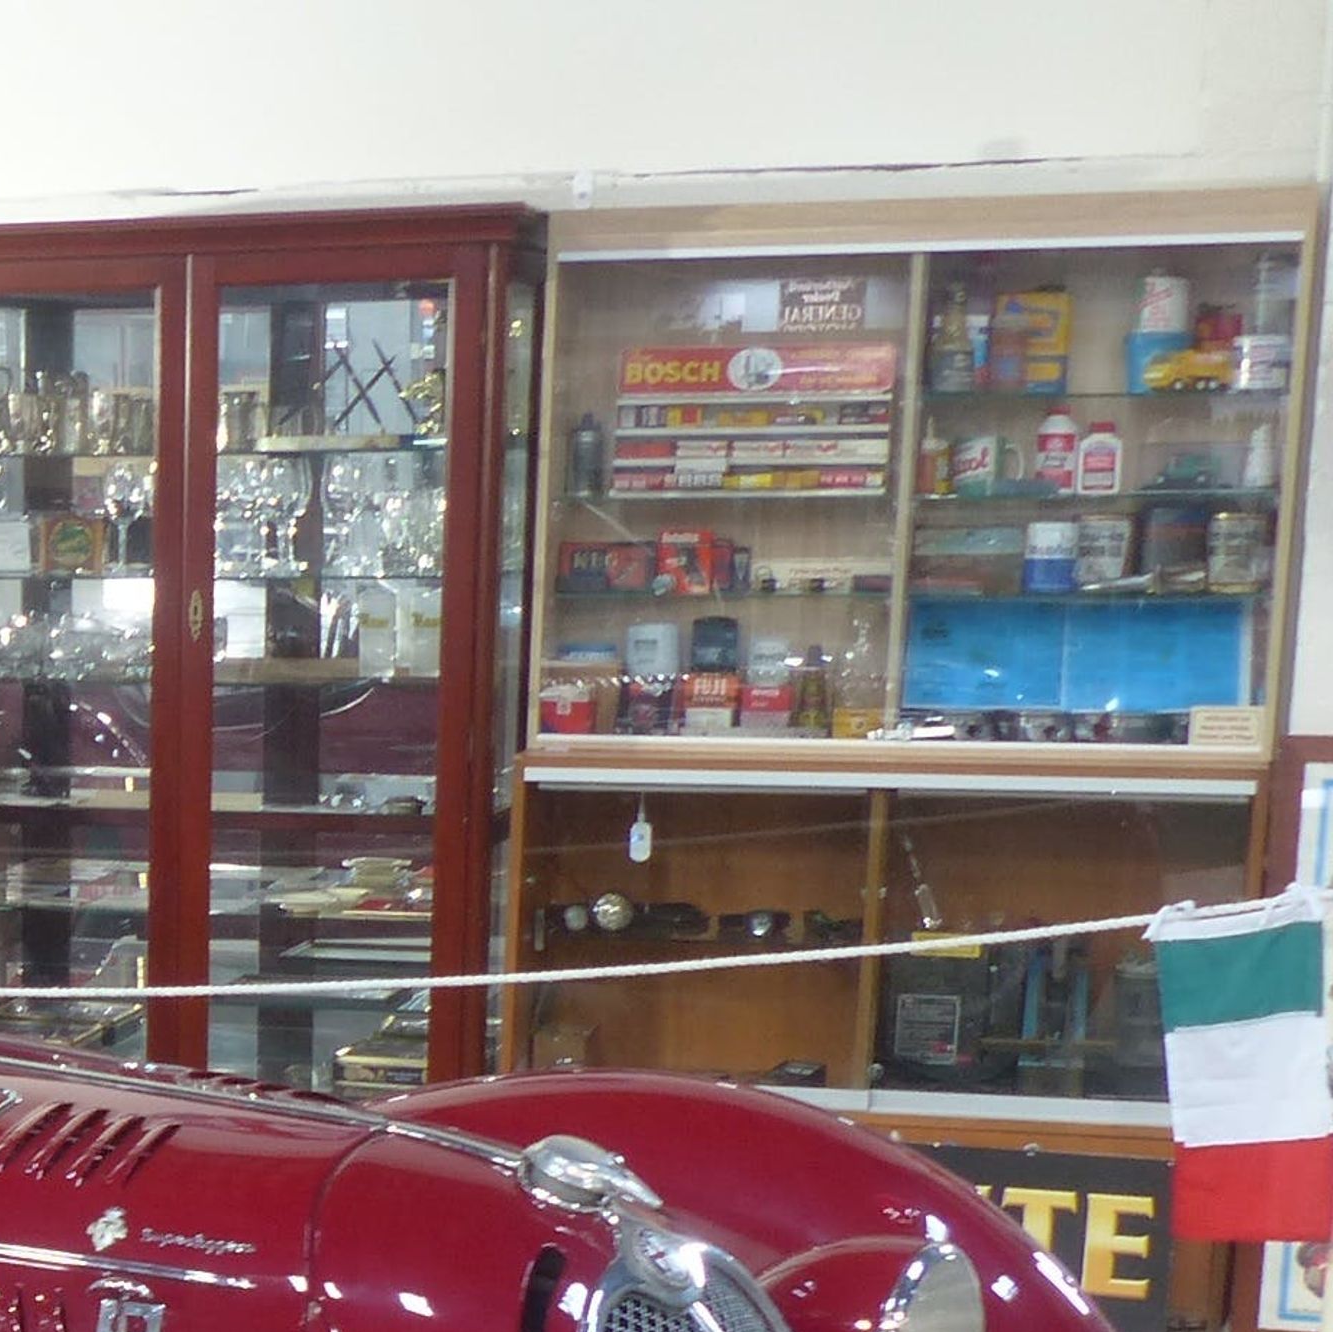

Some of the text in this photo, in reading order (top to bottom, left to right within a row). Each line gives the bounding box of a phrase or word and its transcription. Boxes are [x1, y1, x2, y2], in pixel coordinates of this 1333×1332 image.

[625, 360, 721, 385] BOSCH
[693, 678, 727, 695] FUJI
[974, 1186, 1155, 1300] TE
